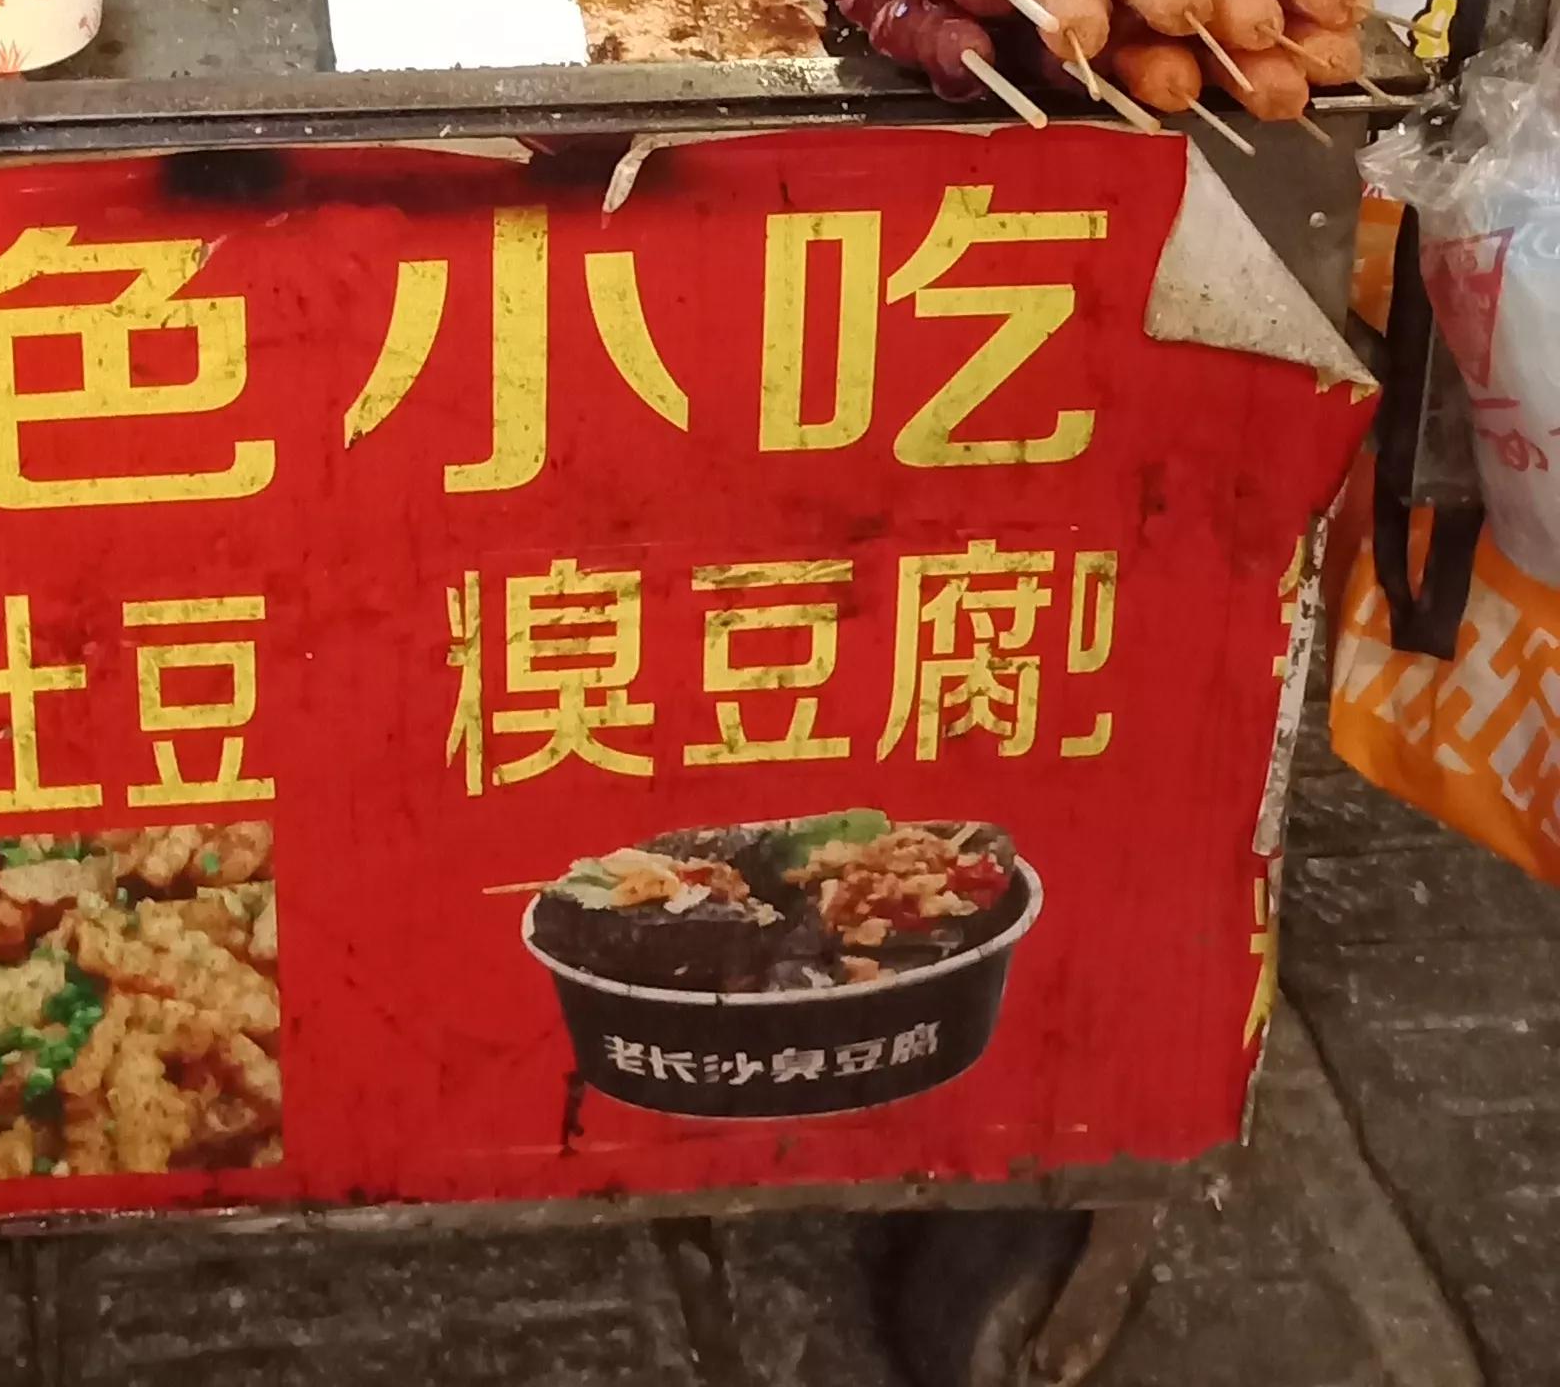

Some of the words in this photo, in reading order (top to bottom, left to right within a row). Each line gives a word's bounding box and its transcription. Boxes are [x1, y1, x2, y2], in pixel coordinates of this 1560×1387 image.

[603, 1020, 942, 1086] 老长沙臭豆腐
